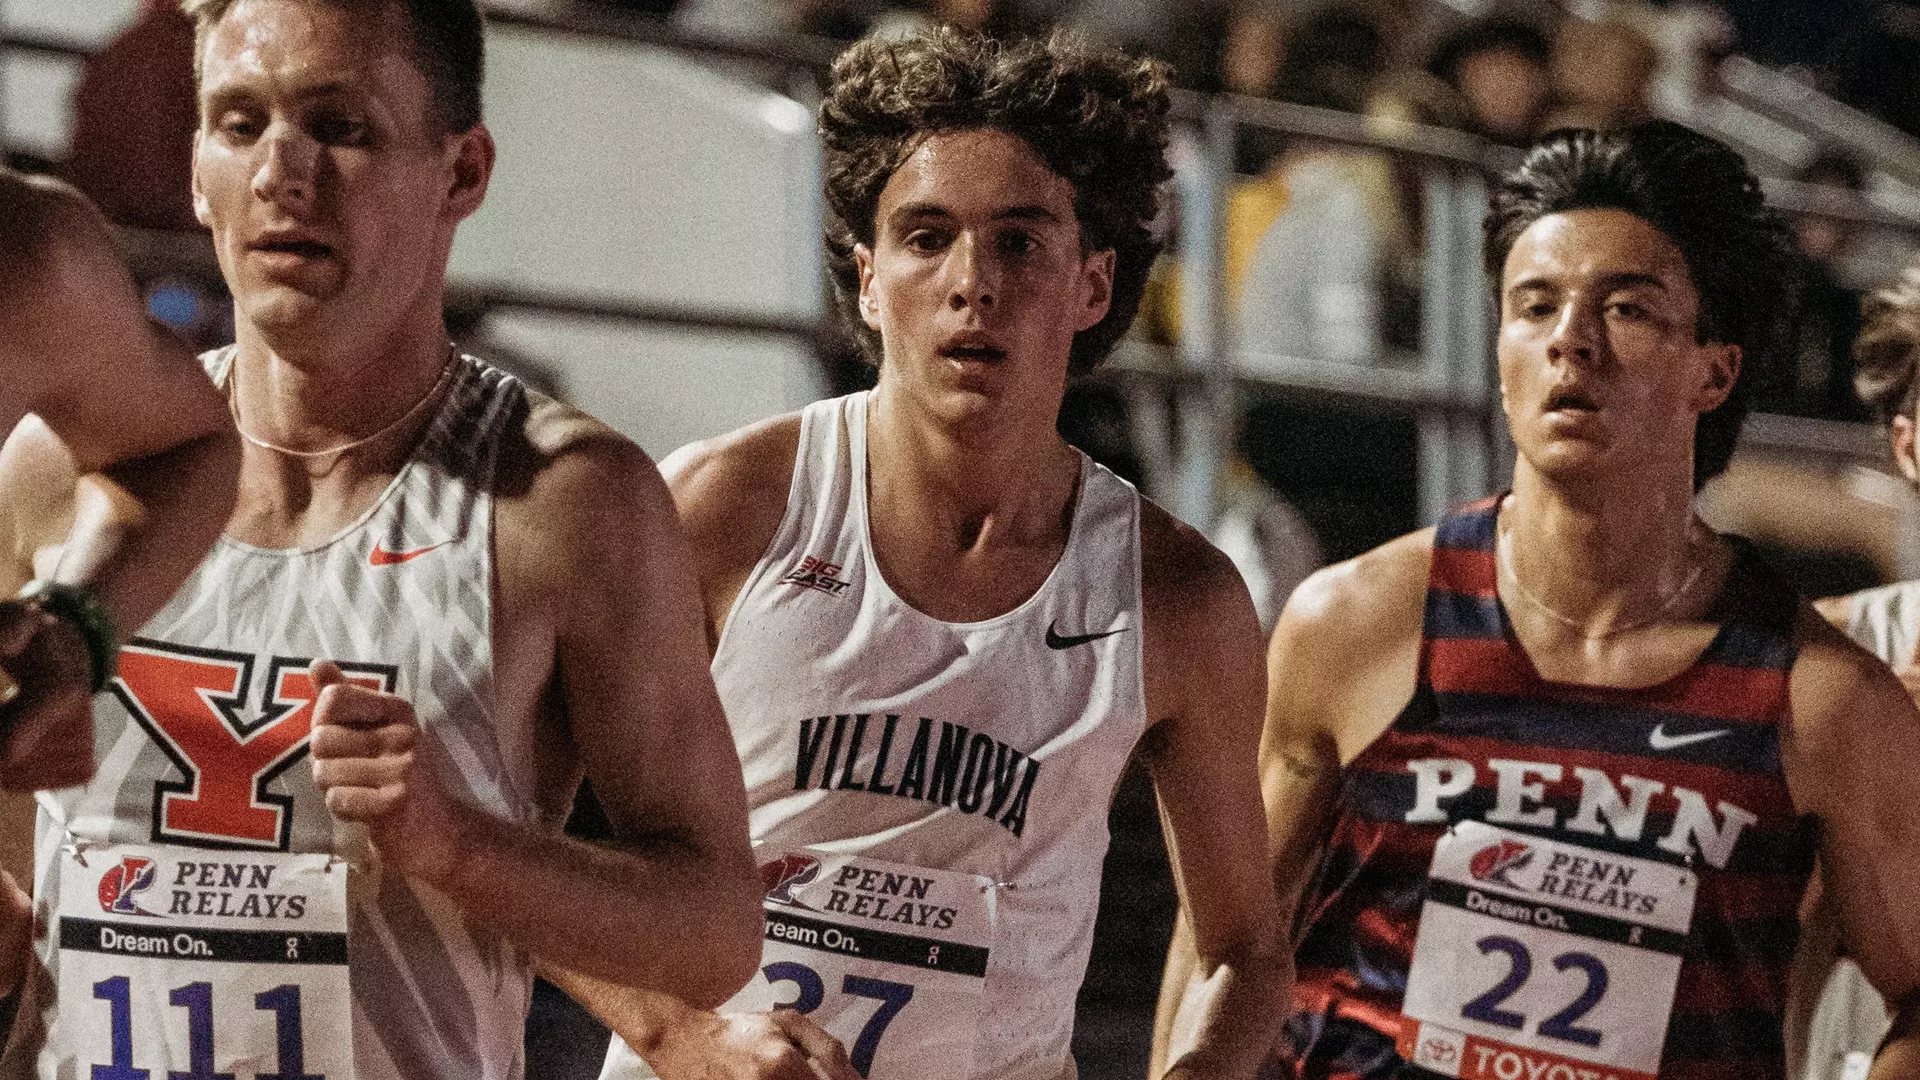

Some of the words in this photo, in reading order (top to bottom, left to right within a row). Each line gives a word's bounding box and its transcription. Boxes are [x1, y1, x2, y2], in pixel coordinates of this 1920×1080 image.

[794, 713, 1040, 838] VILLANOVA
[1405, 758, 1758, 869] PENN
[173, 861, 276, 889] PENN
[834, 865, 935, 900] PENN
[1549, 851, 1638, 886] PENN
[168, 890, 308, 919] RELAYS
[824, 890, 958, 930] RELAYS
[1466, 892, 1532, 923] Dream
[1537, 875, 1659, 915] RELAYS
[100, 927, 169, 955] Dream
[173, 934, 214, 957] On.
[823, 928, 860, 953] On.
[1461, 934, 1609, 1048] 22
[91, 975, 326, 1080] 111
[1474, 1045, 1620, 1080] TOYO
